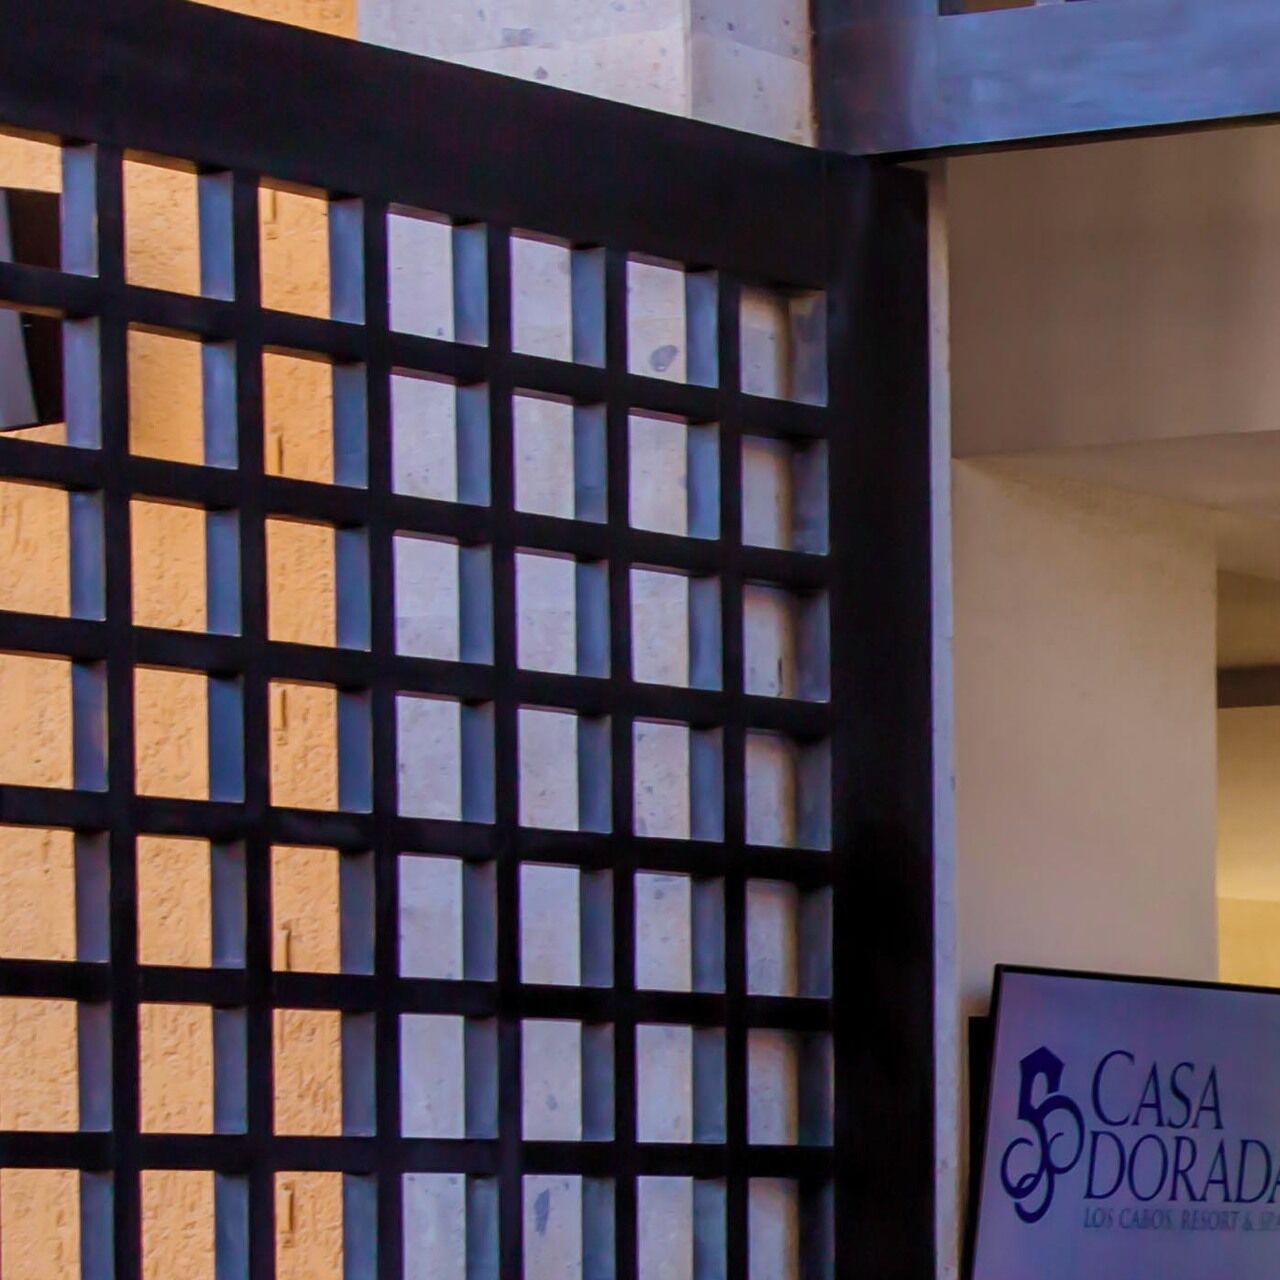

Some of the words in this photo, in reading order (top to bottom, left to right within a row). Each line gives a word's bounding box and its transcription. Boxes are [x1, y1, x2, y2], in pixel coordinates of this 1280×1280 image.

[1091, 1050, 1224, 1130] CASA
[1083, 1207, 1114, 1229] LOS
[1118, 1208, 1173, 1230] CABOS
[1181, 1209, 1240, 1231] RESORT
